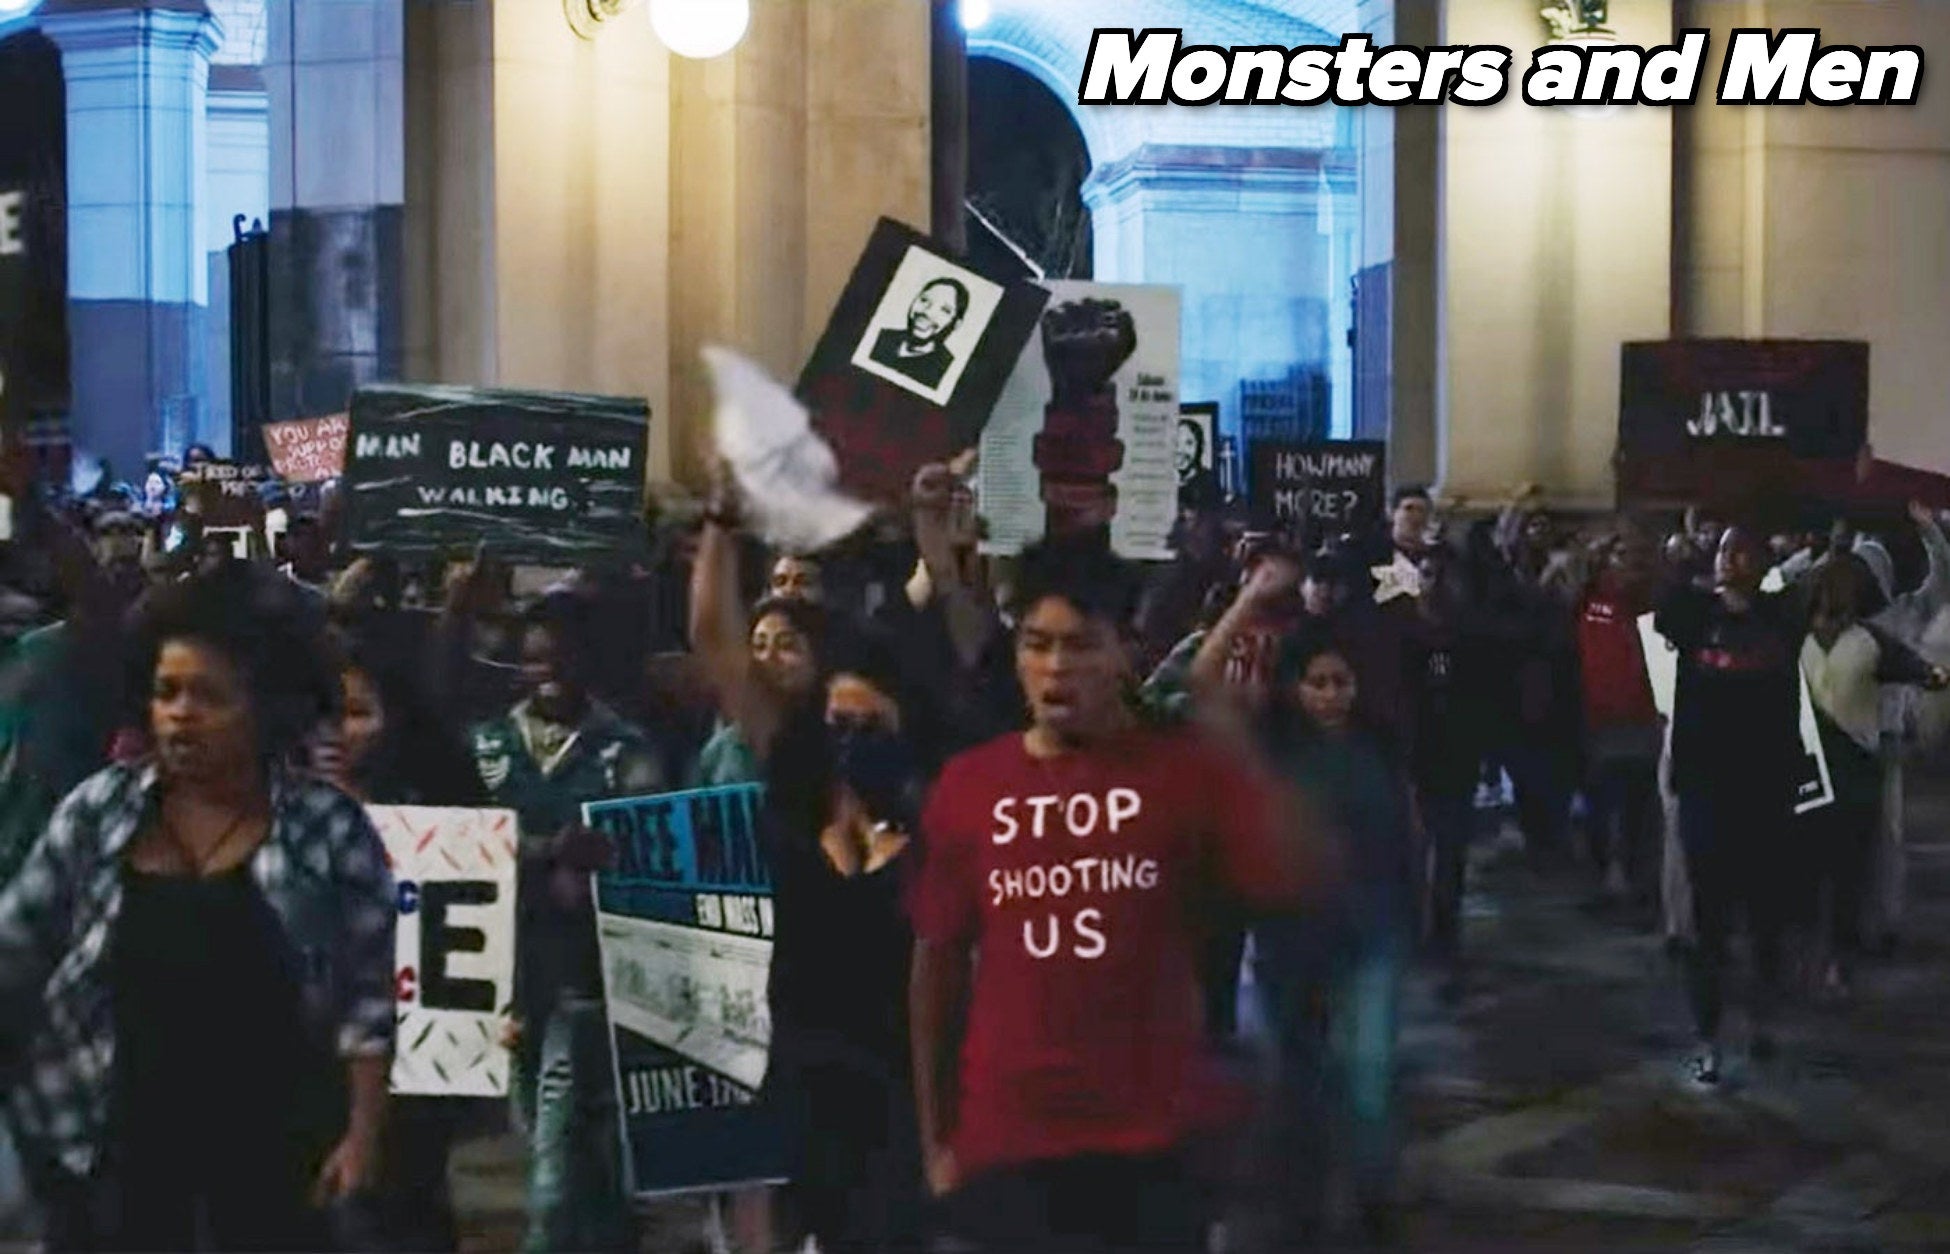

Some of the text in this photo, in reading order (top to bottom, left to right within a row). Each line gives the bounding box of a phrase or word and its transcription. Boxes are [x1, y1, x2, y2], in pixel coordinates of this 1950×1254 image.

[269, 423, 310, 446] YOU
[1686, 390, 1785, 437] JAIL
[355, 431, 631, 470] MAN BLACK MAN
[417, 486, 569, 510] WALKING
[991, 787, 1142, 845] STOP
[988, 854, 1159, 906] SHOOTING
[1023, 907, 1107, 959] US
[627, 1065, 701, 1115] JUNE
